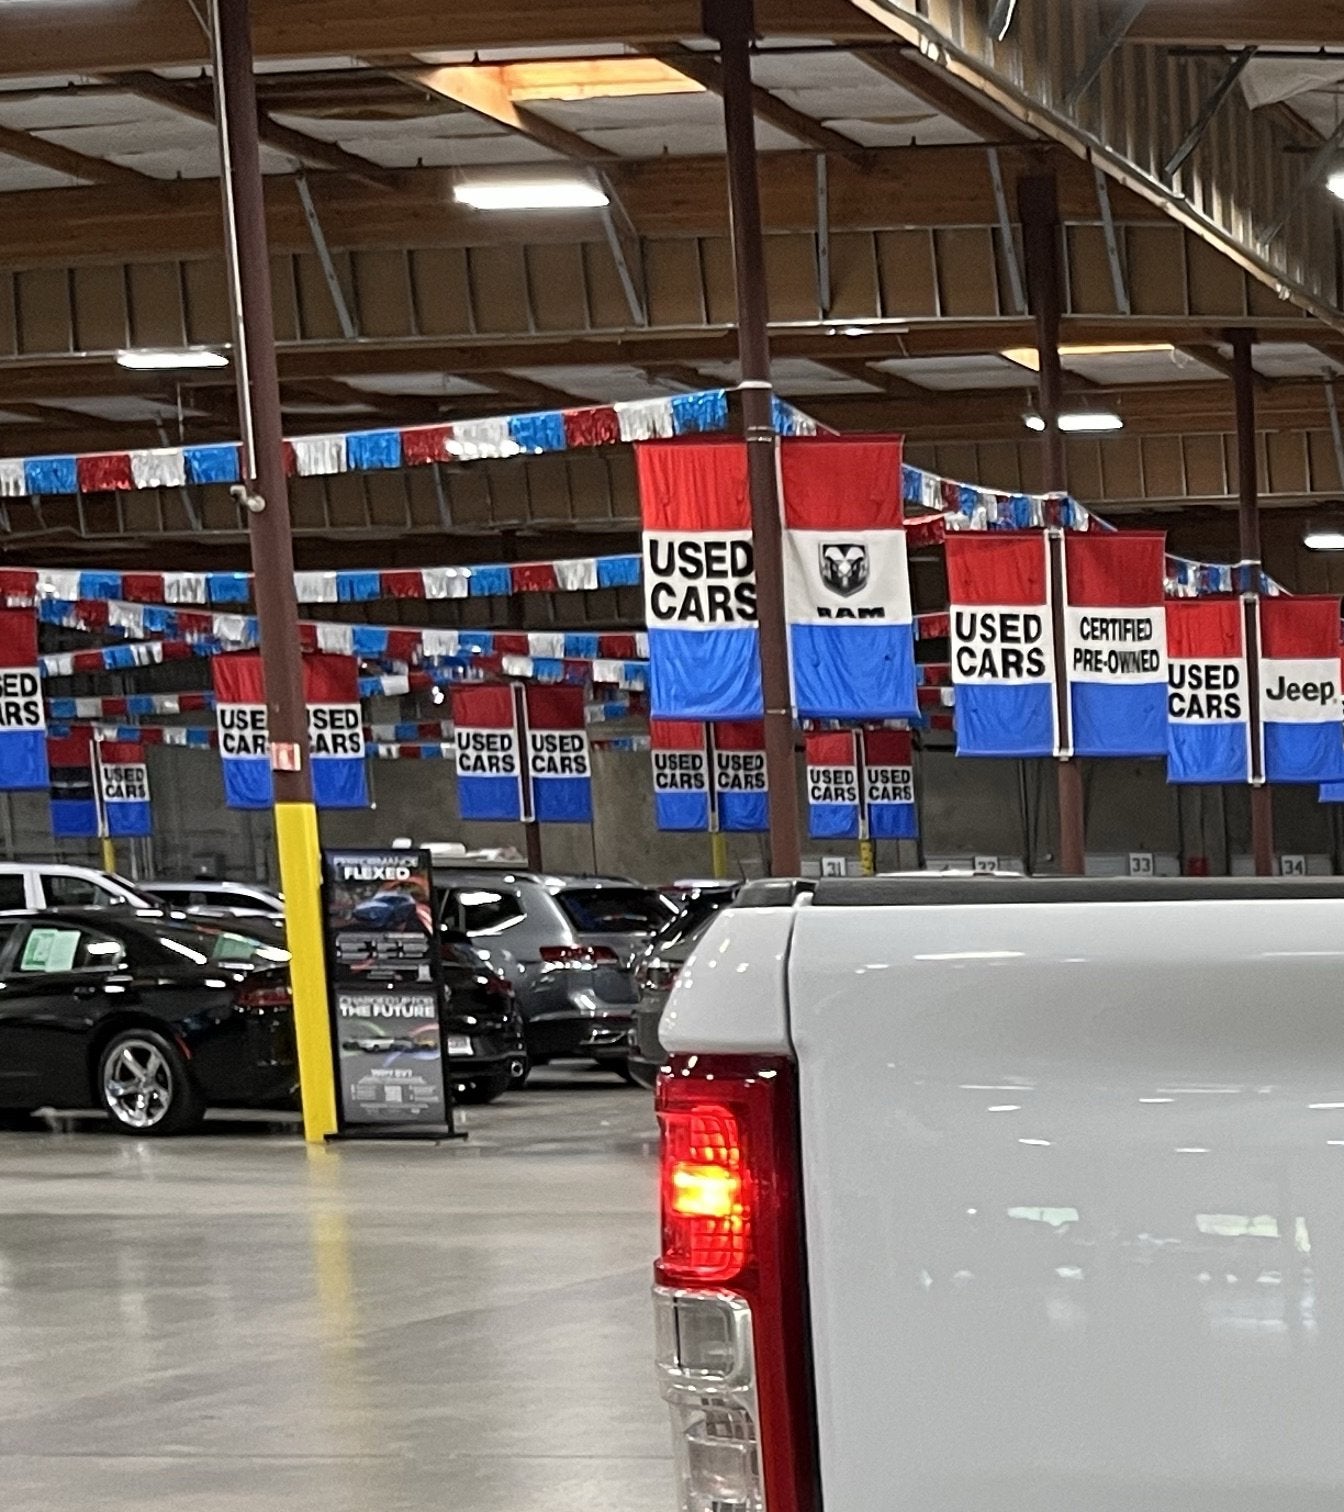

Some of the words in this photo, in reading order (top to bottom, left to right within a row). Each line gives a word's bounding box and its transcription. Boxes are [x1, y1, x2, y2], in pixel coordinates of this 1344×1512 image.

[649, 539, 754, 580] USED
[650, 582, 758, 622] CARS
[955, 612, 1043, 644] USED
[1079, 616, 1153, 642] CERTIFIED
[956, 646, 1046, 678] CARS
[1073, 648, 1160, 674] PRE-OWNED
[0, 673, 38, 697] ED
[1167, 664, 1240, 690] USED
[1265, 676, 1336, 706] Jeep
[1168, 692, 1242, 719] CARS
[220, 709, 266, 731] USE
[306, 708, 359, 730] SED
[223, 733, 268, 754] CAR
[308, 733, 361, 754] ARS
[457, 732, 513, 752] USED
[531, 734, 585, 753] USED
[459, 753, 516, 773] CARS
[531, 754, 588, 774] CARS
[654, 754, 704, 771] USED
[717, 753, 764, 771] USED
[104, 768, 144, 782] USED
[655, 771, 705, 789] CARS
[717, 772, 766, 789] CARS
[810, 769, 855, 785] USED
[868, 769, 911, 785] USED
[105, 784, 146, 798] CARS
[811, 786, 857, 802] CARS
[868, 785, 912, 801] CARS
[344, 866, 411, 880] FLEXED
[340, 1004, 371, 1017] THE
[373, 1004, 435, 1018] FUTURE
